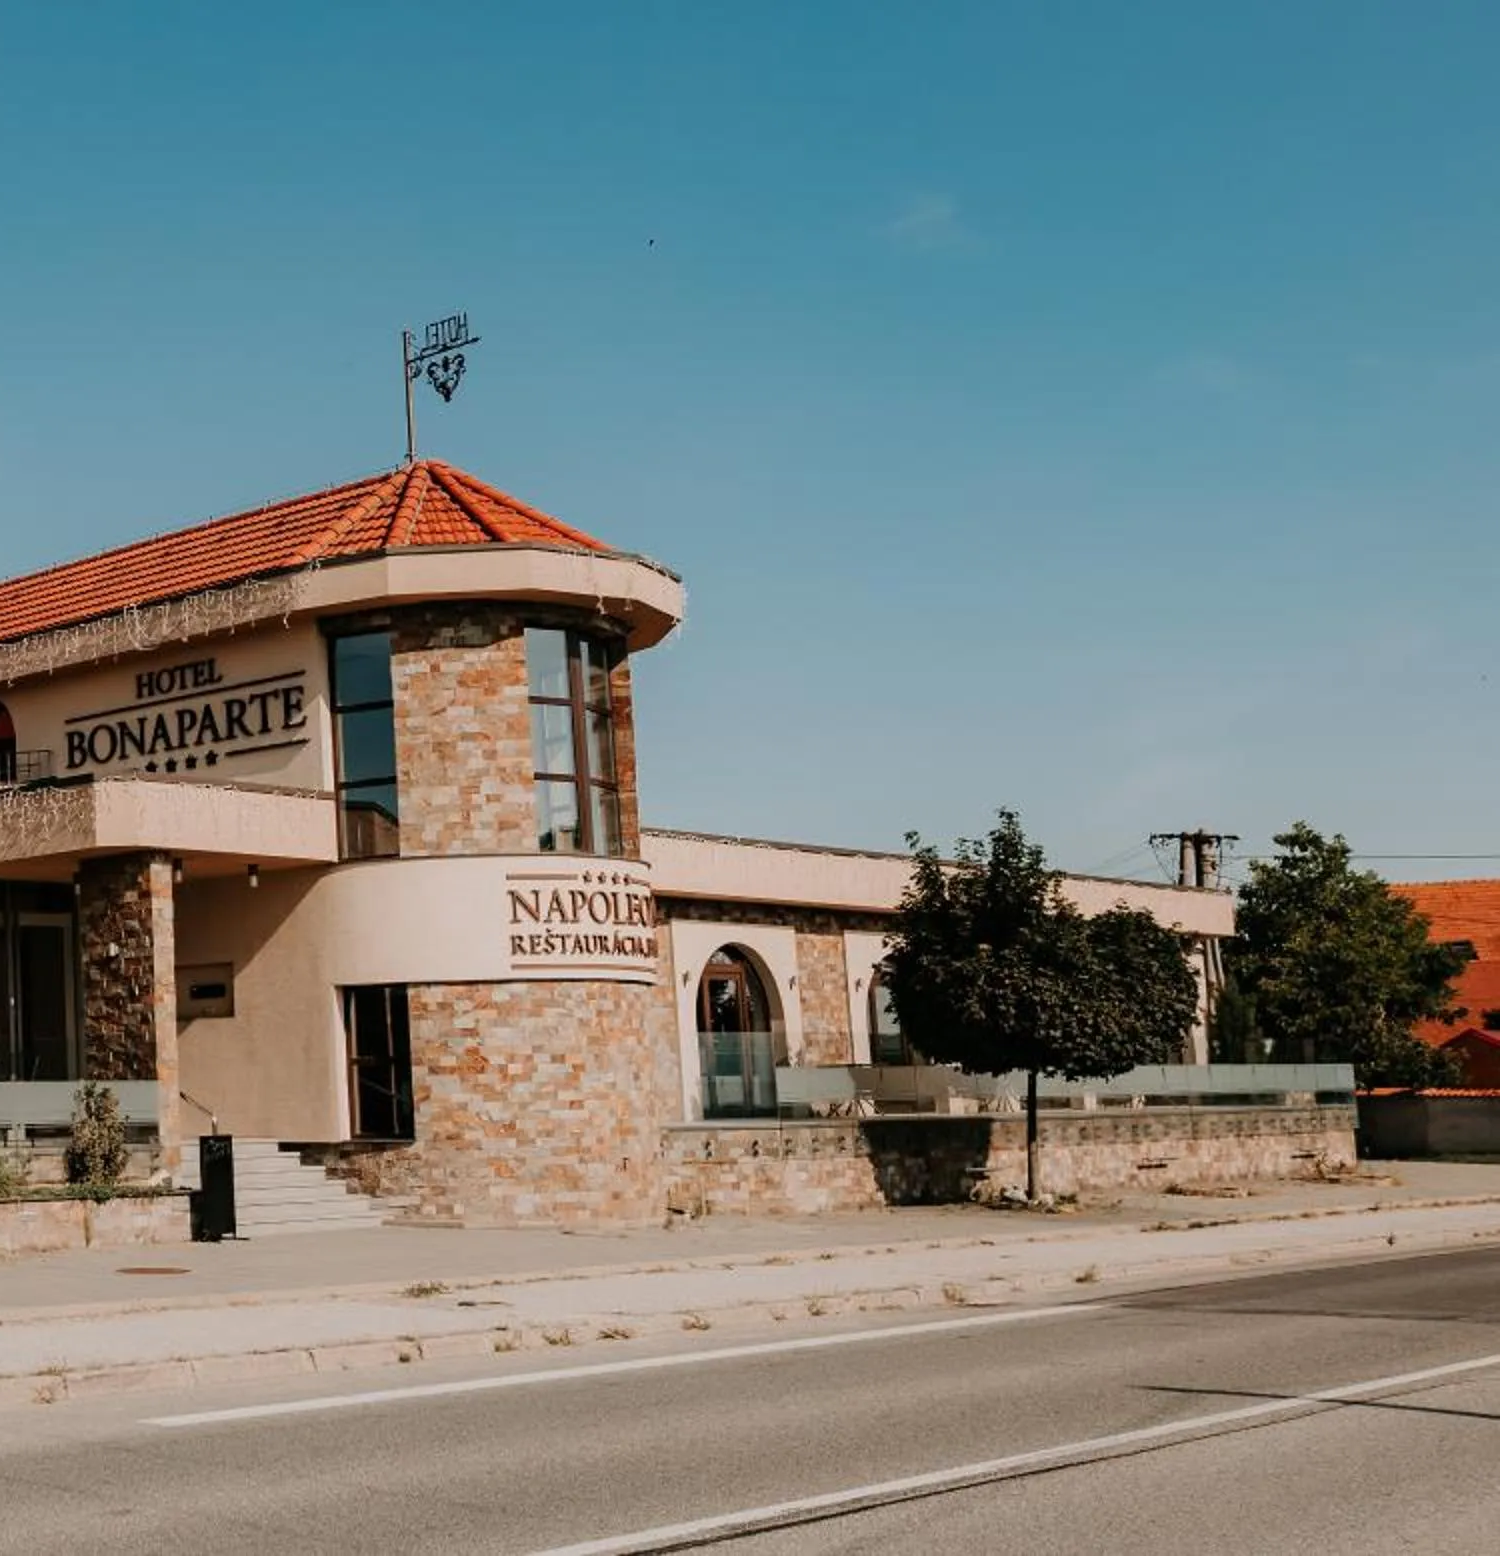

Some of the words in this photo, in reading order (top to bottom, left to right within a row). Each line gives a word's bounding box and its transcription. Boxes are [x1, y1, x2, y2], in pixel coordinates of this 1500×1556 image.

[136, 657, 223, 699] HOTEL
[65, 686, 308, 769] BONAPARTE
[506, 887, 658, 928] NAPOLE
